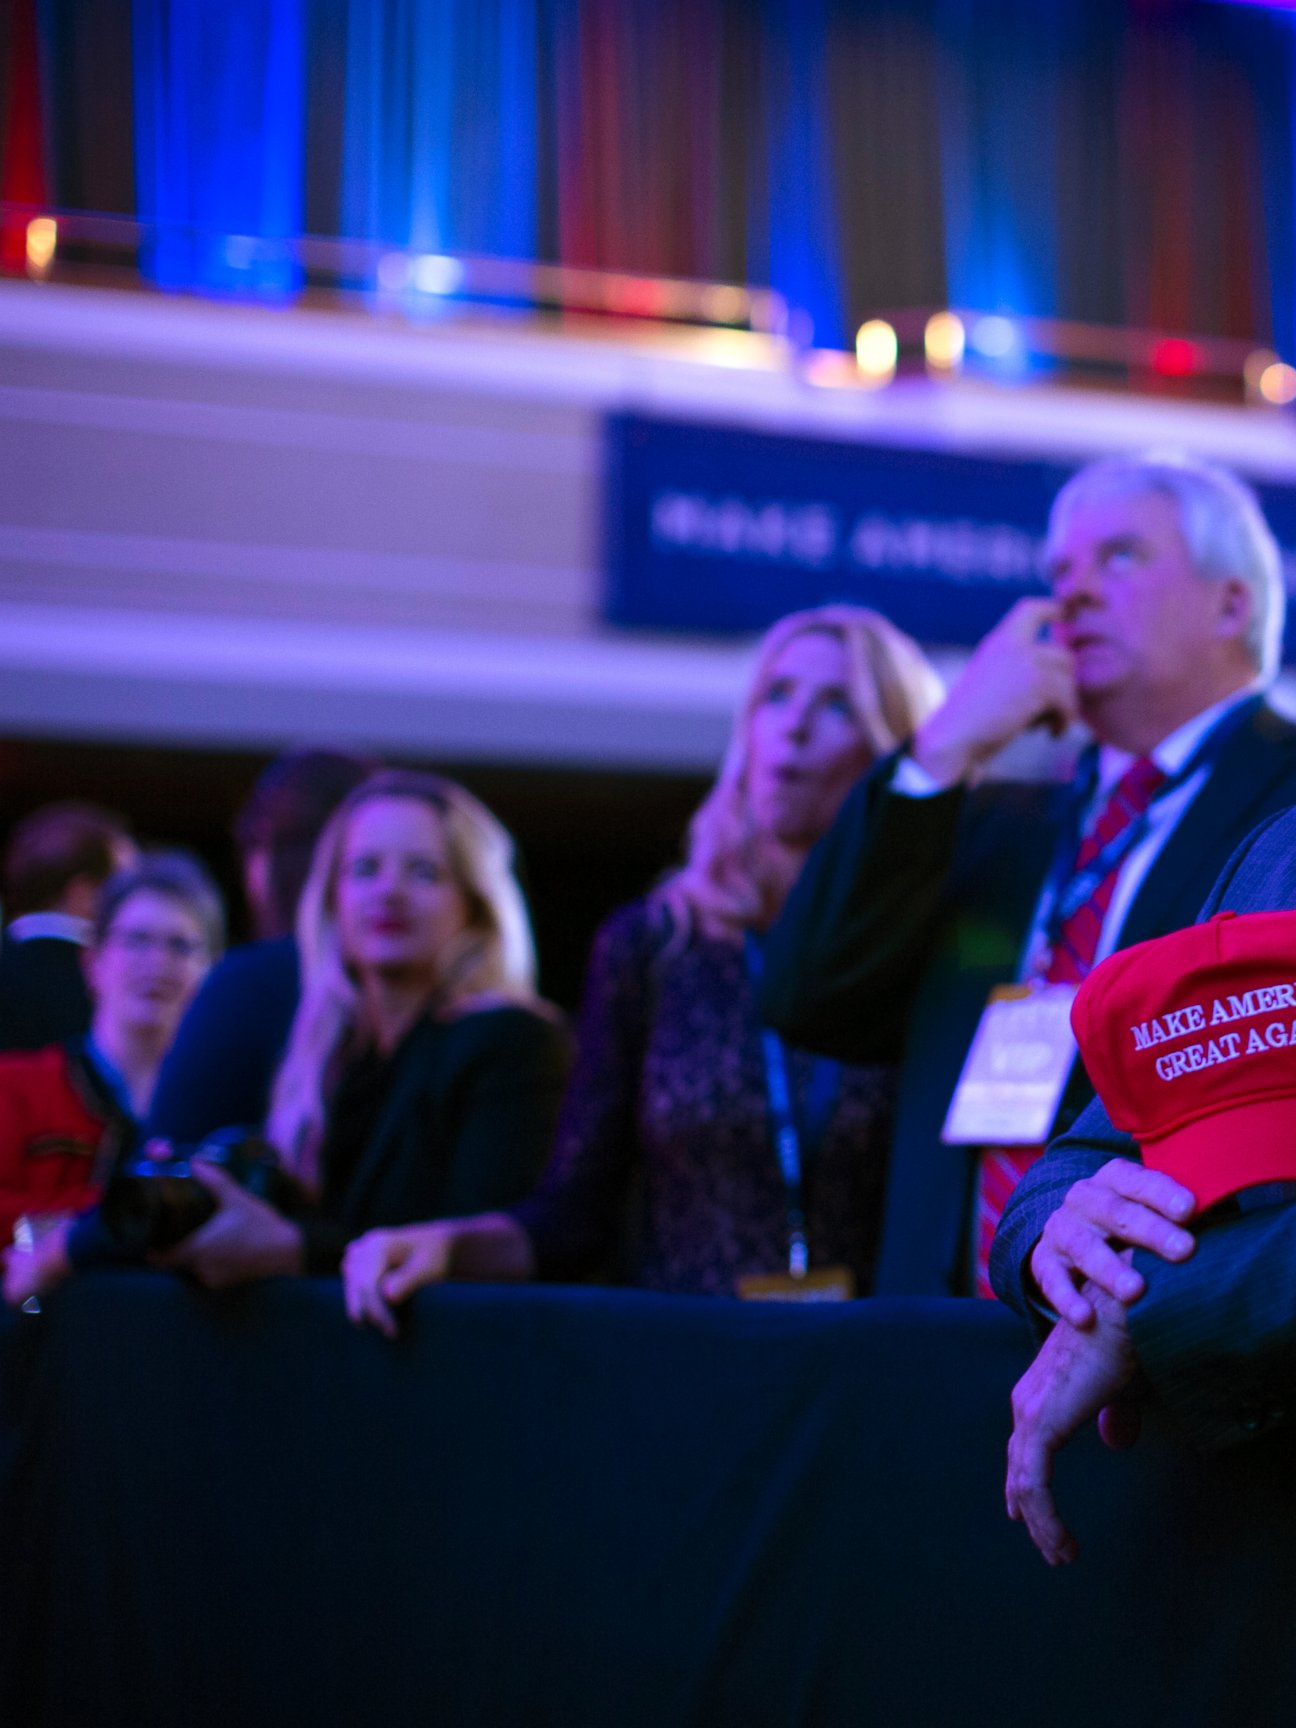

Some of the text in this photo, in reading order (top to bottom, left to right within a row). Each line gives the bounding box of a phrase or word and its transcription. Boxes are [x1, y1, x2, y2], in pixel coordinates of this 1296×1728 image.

[652, 491, 836, 566] MAKE
[1130, 1005, 1206, 1051] MAKE
[1155, 1033, 1241, 1081] GREAT
